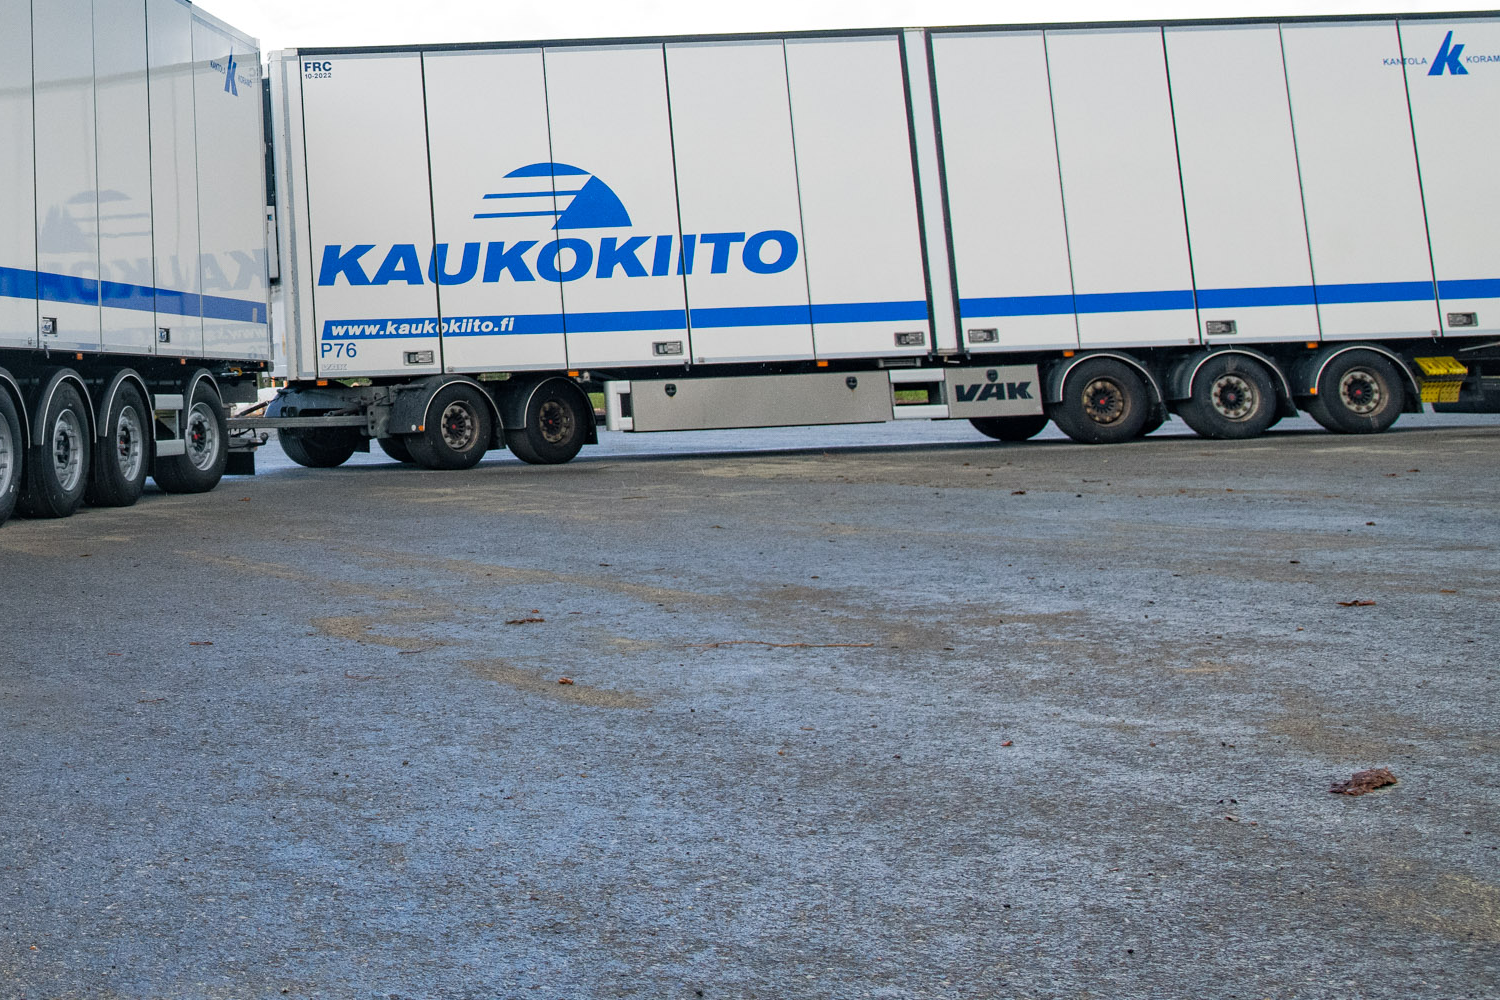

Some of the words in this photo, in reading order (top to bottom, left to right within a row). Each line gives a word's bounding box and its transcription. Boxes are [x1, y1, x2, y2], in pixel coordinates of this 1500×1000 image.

[304, 61, 332, 72] FRC
[1383, 57, 1427, 66] KANTOLA
[318, 229, 799, 286] KAUKOKIITO
[331, 317, 514, 337] www.kaukokiito.fi
[321, 342, 357, 359] P76
[955, 382, 1033, 402] VAK
